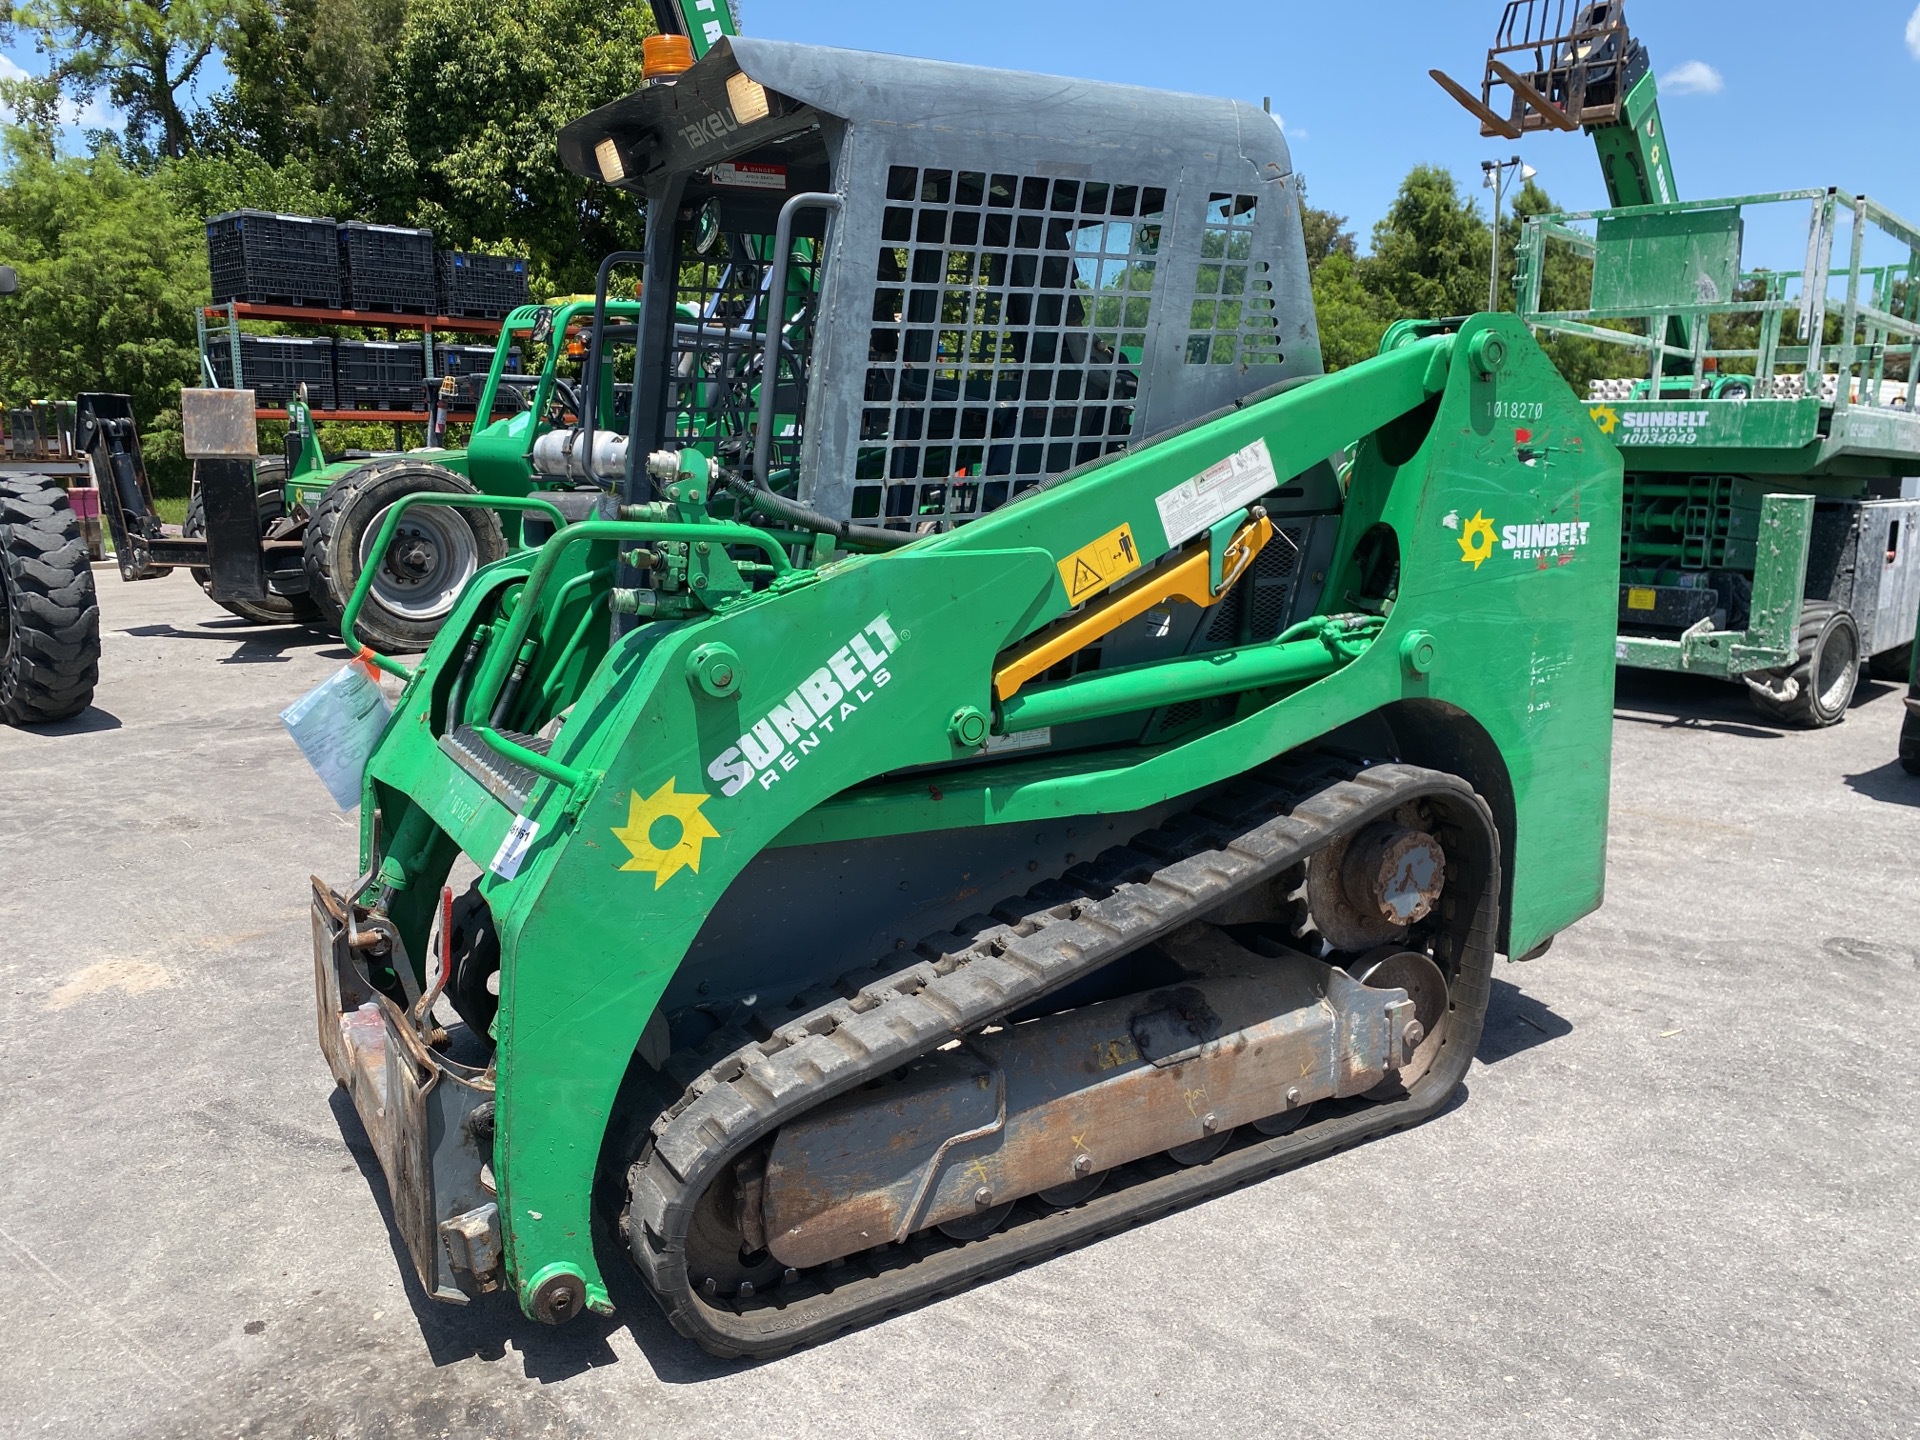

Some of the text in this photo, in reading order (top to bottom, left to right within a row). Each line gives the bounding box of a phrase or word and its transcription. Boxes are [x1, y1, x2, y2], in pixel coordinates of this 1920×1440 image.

[1486, 401, 1543, 419] 1018270
[1622, 410, 1709, 427] SUNBELT
[1621, 433, 1697, 445] 10034949
[1502, 522, 1590, 549] SUNBELT
[1513, 547, 1575, 559] RENTA
[707, 609, 902, 797] SUNBELT
[758, 667, 892, 790] RENTALS
